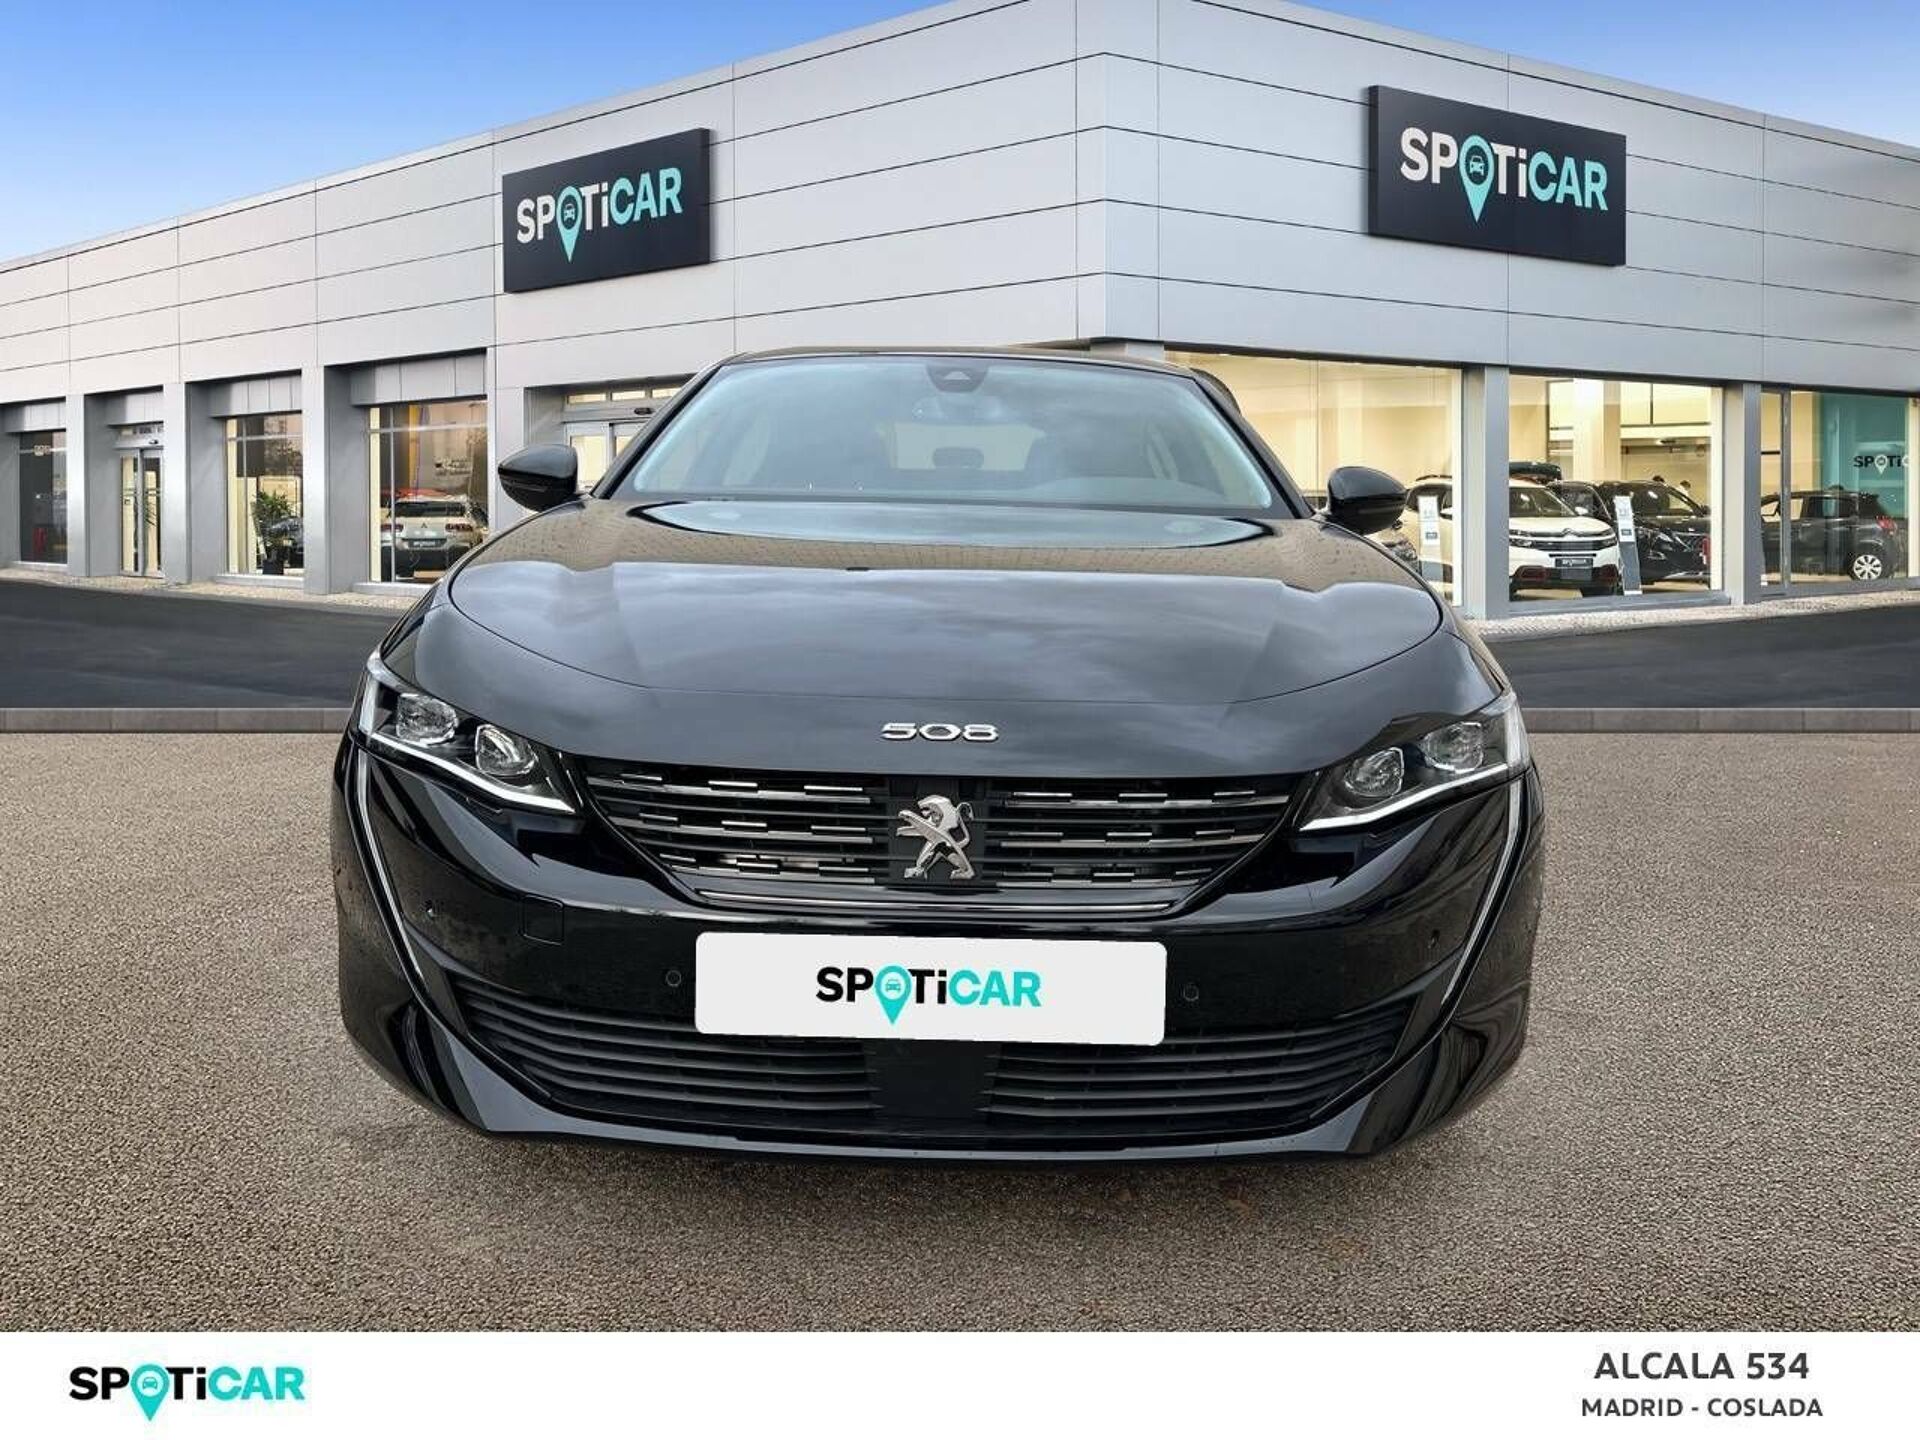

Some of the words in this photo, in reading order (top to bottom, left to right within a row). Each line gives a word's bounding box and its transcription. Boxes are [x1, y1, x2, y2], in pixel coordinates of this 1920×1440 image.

[516, 167, 684, 263] SPOTiCAR
[1400, 126, 1609, 223] SPOTiCAR
[881, 722, 999, 742] 508
